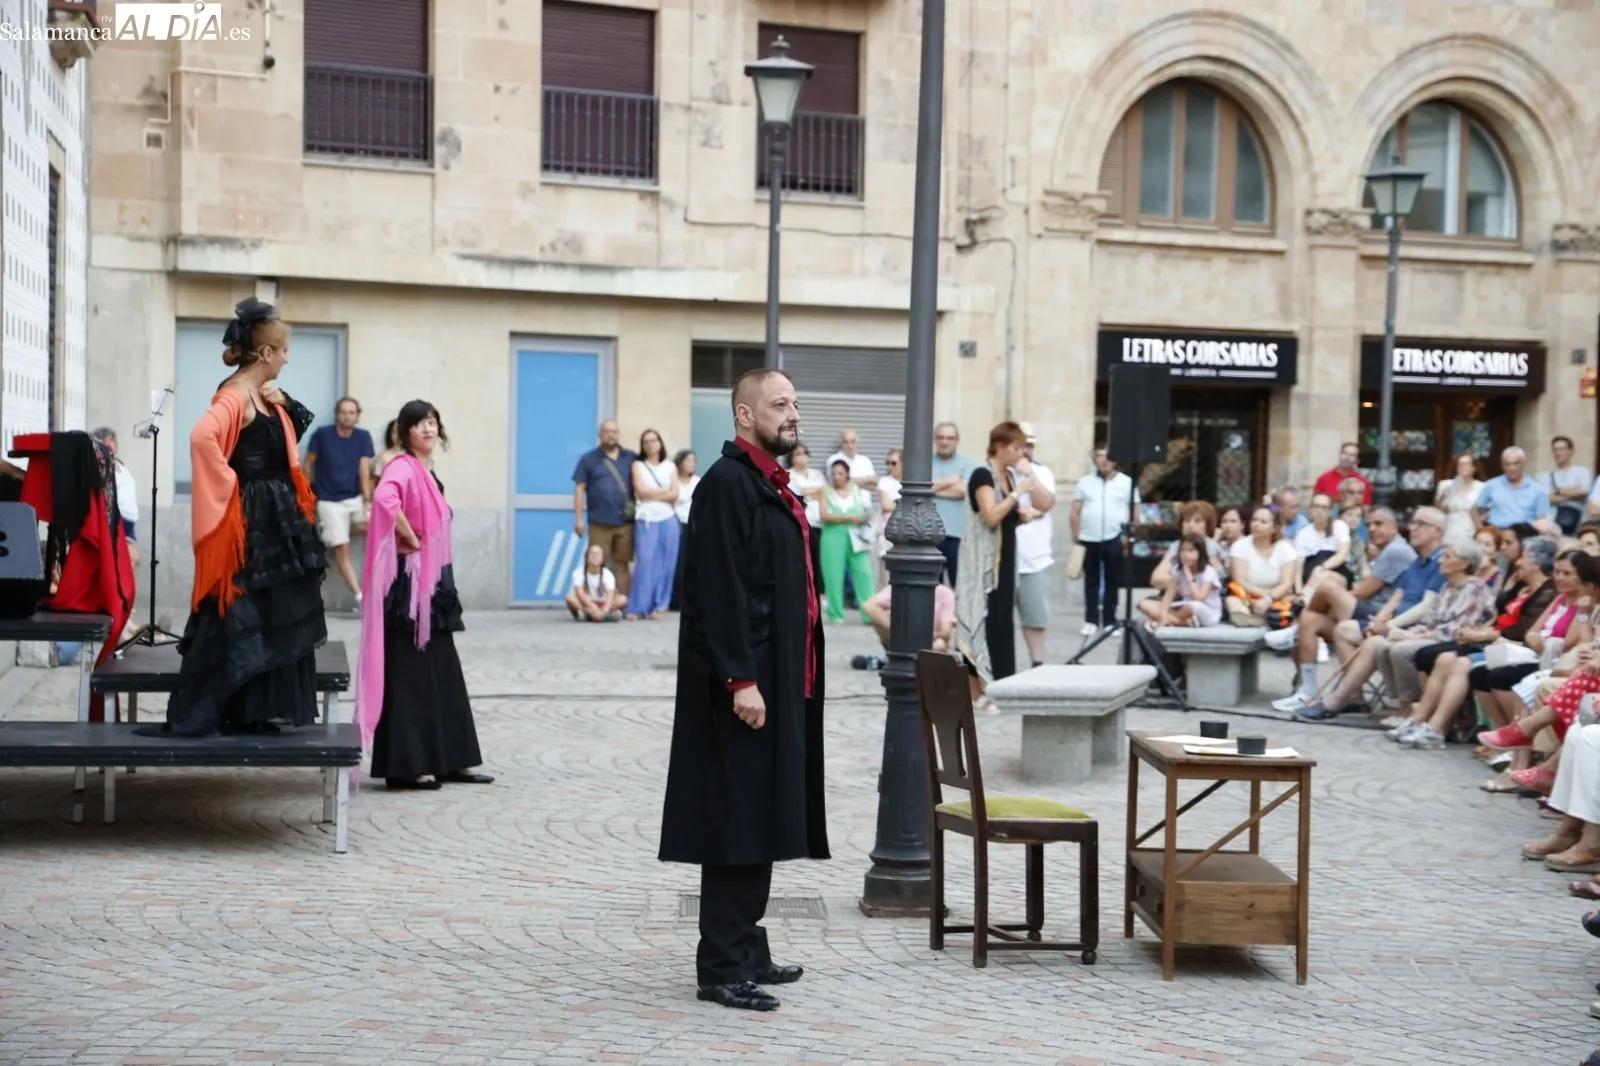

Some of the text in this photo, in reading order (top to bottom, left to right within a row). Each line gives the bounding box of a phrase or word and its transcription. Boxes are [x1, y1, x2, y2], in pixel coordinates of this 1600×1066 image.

[1122, 337, 1279, 368] LETRAS CORSARIAS
[1392, 347, 1529, 376] ETRAS CORSARIAS
